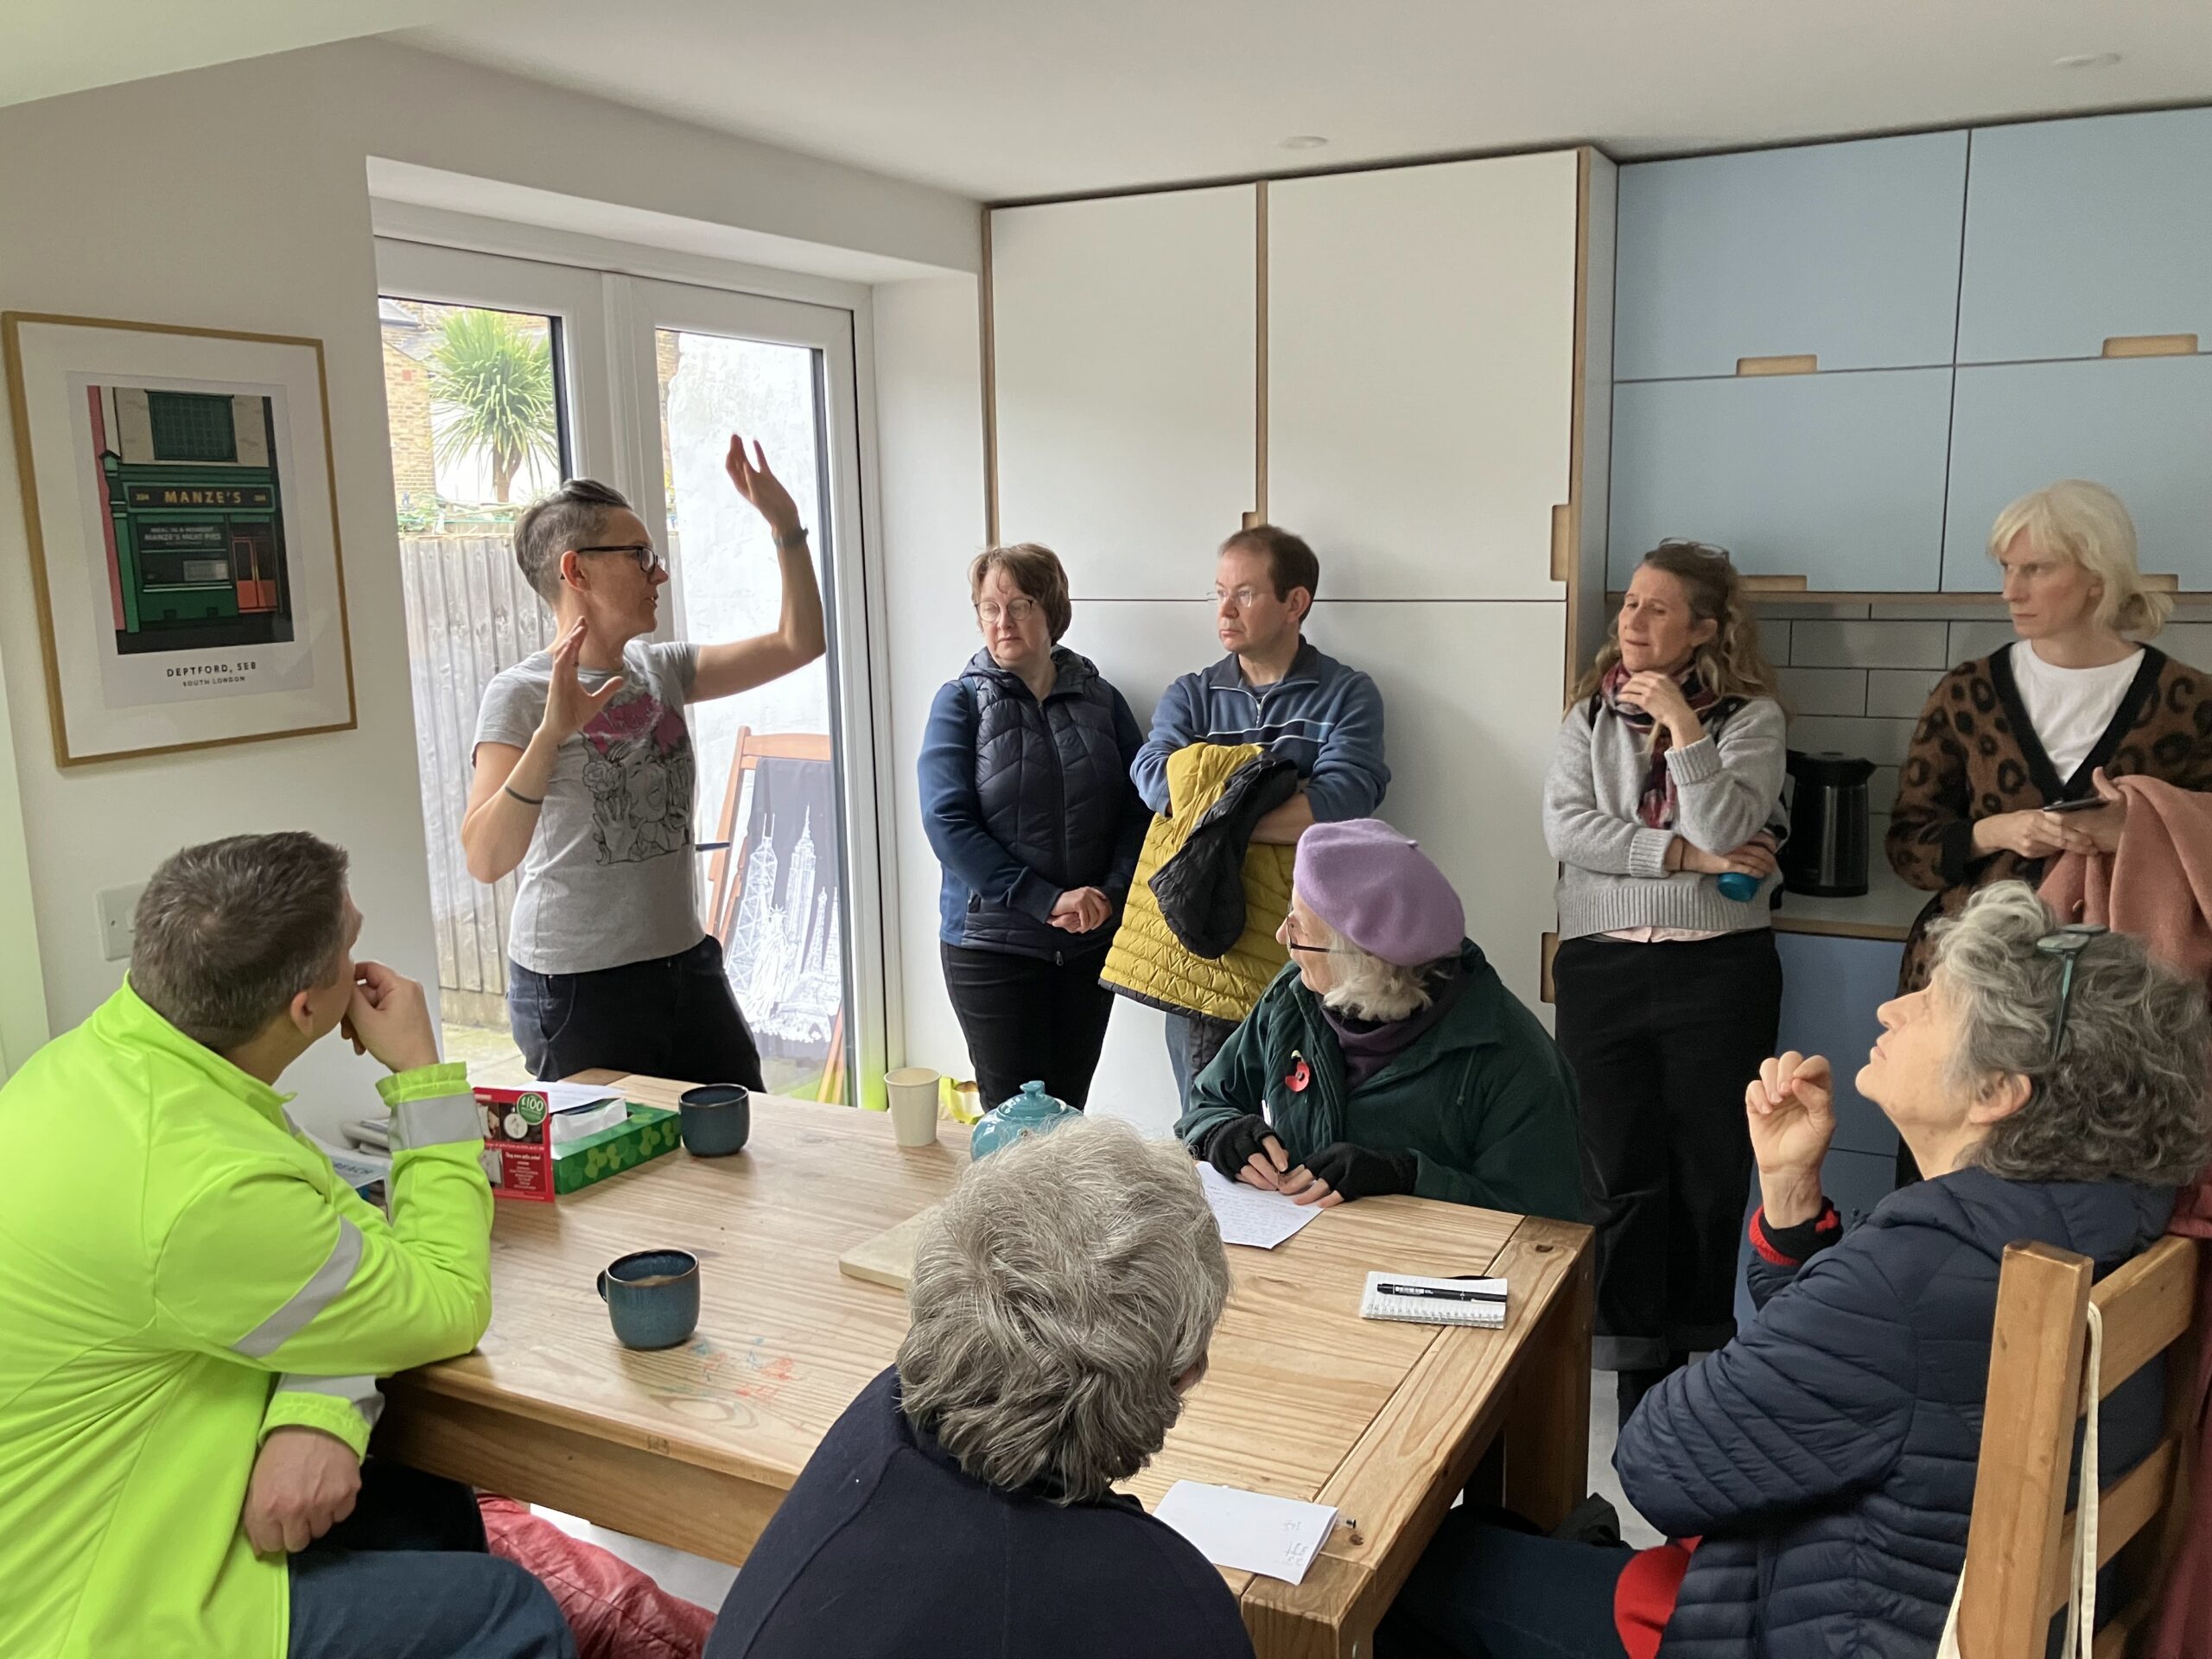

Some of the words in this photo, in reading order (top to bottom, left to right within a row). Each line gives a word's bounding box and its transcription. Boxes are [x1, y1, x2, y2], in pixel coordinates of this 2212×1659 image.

[164, 491, 241, 504] MANZE'S
[167, 664, 232, 677] DEPTFORD,
[213, 676, 245, 685] LONDON
[521, 1096, 544, 1112] £100
